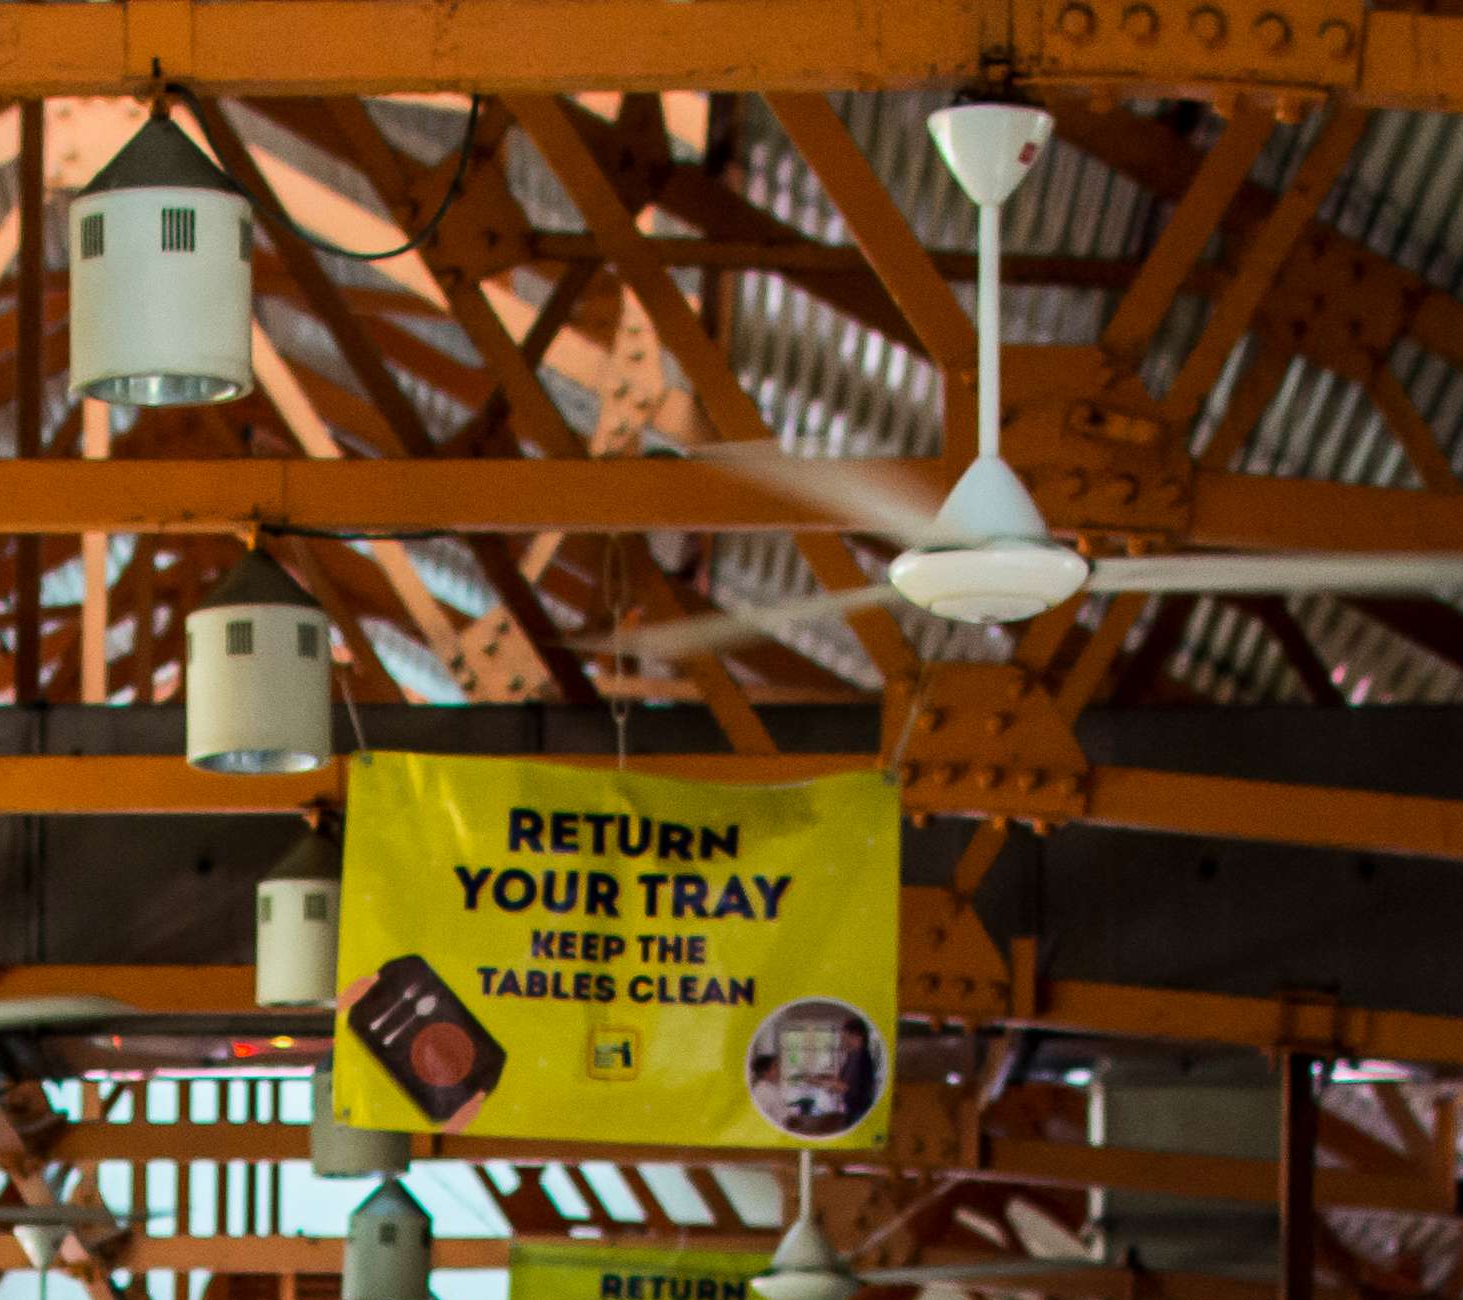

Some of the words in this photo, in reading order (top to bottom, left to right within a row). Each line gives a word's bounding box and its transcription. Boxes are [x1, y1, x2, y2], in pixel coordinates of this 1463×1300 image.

[508, 807, 739, 861] RETURN
[453, 865, 621, 919] YOUR
[637, 873, 792, 922] TRAY
[531, 930, 626, 964] KEEP
[637, 934, 706, 965] THE
[477, 967, 616, 1003] TABLES
[627, 974, 756, 1007] CLEAN
